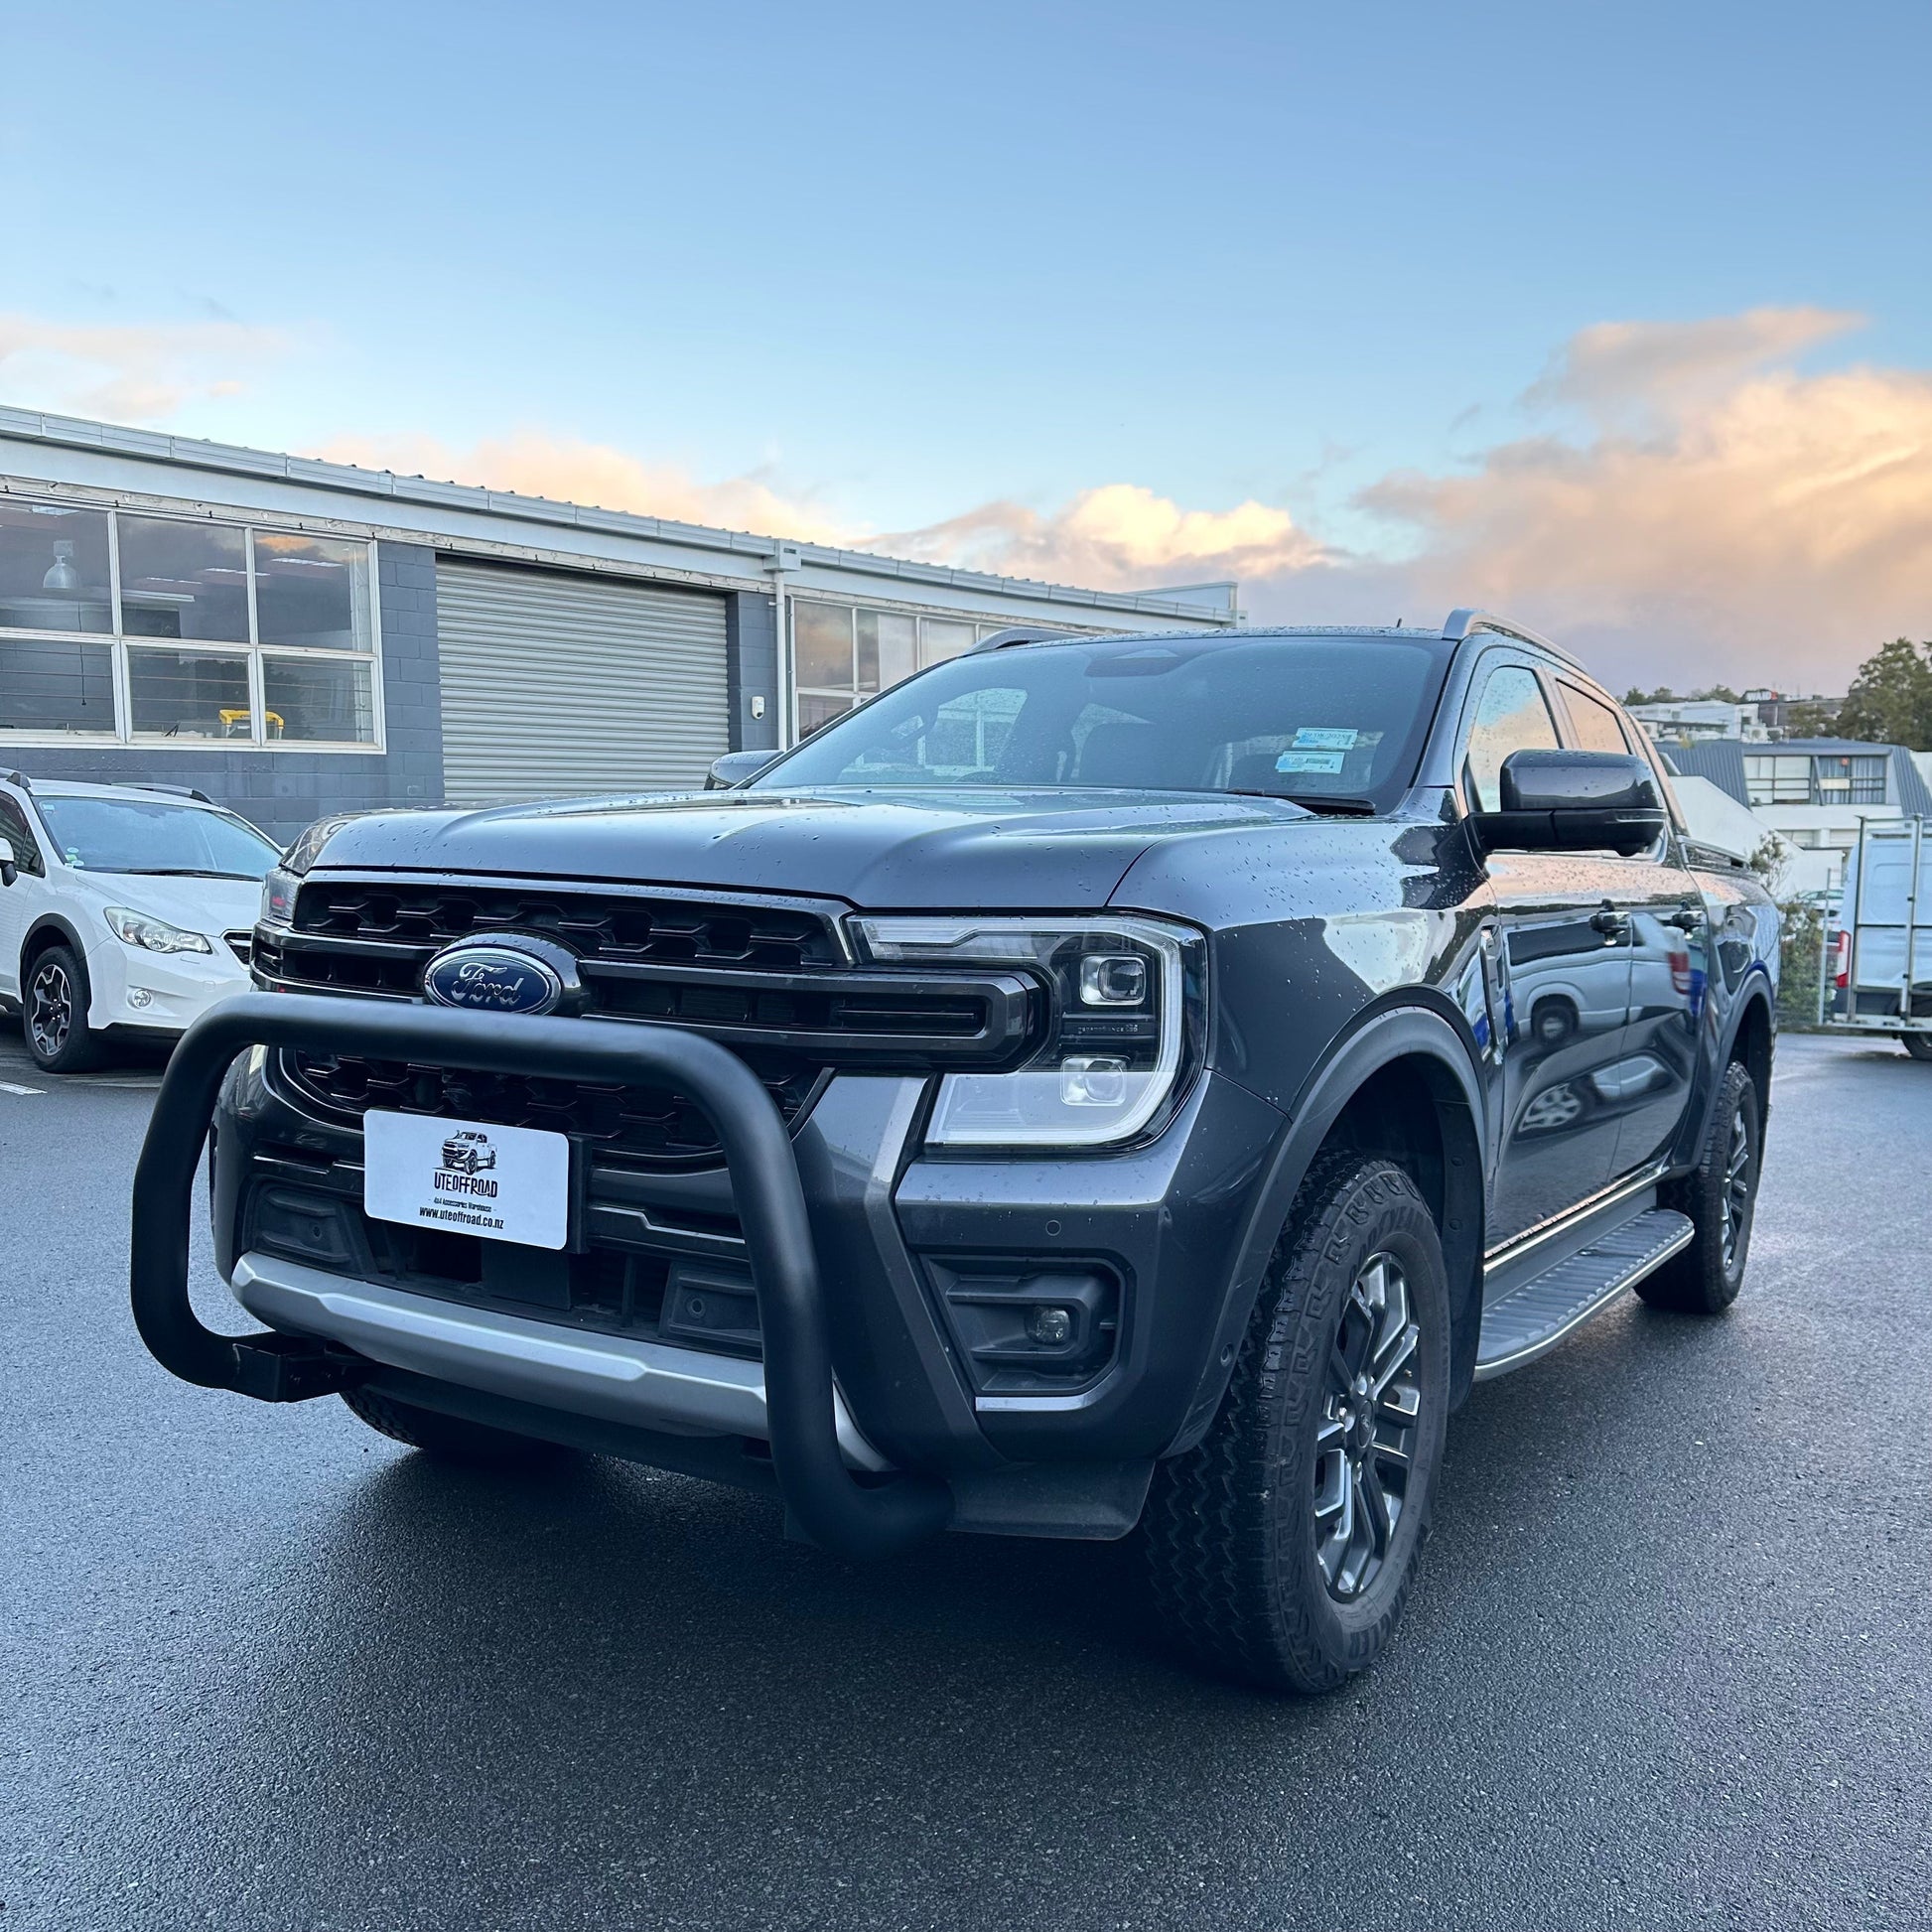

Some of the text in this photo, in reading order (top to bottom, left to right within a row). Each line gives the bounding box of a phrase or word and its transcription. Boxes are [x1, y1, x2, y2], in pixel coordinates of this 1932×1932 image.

[451, 962, 524, 1006] Ford
[434, 1172, 497, 1198] UTEOFFROAD
[420, 1206, 503, 1229] www.uteoffroad.co.nz
